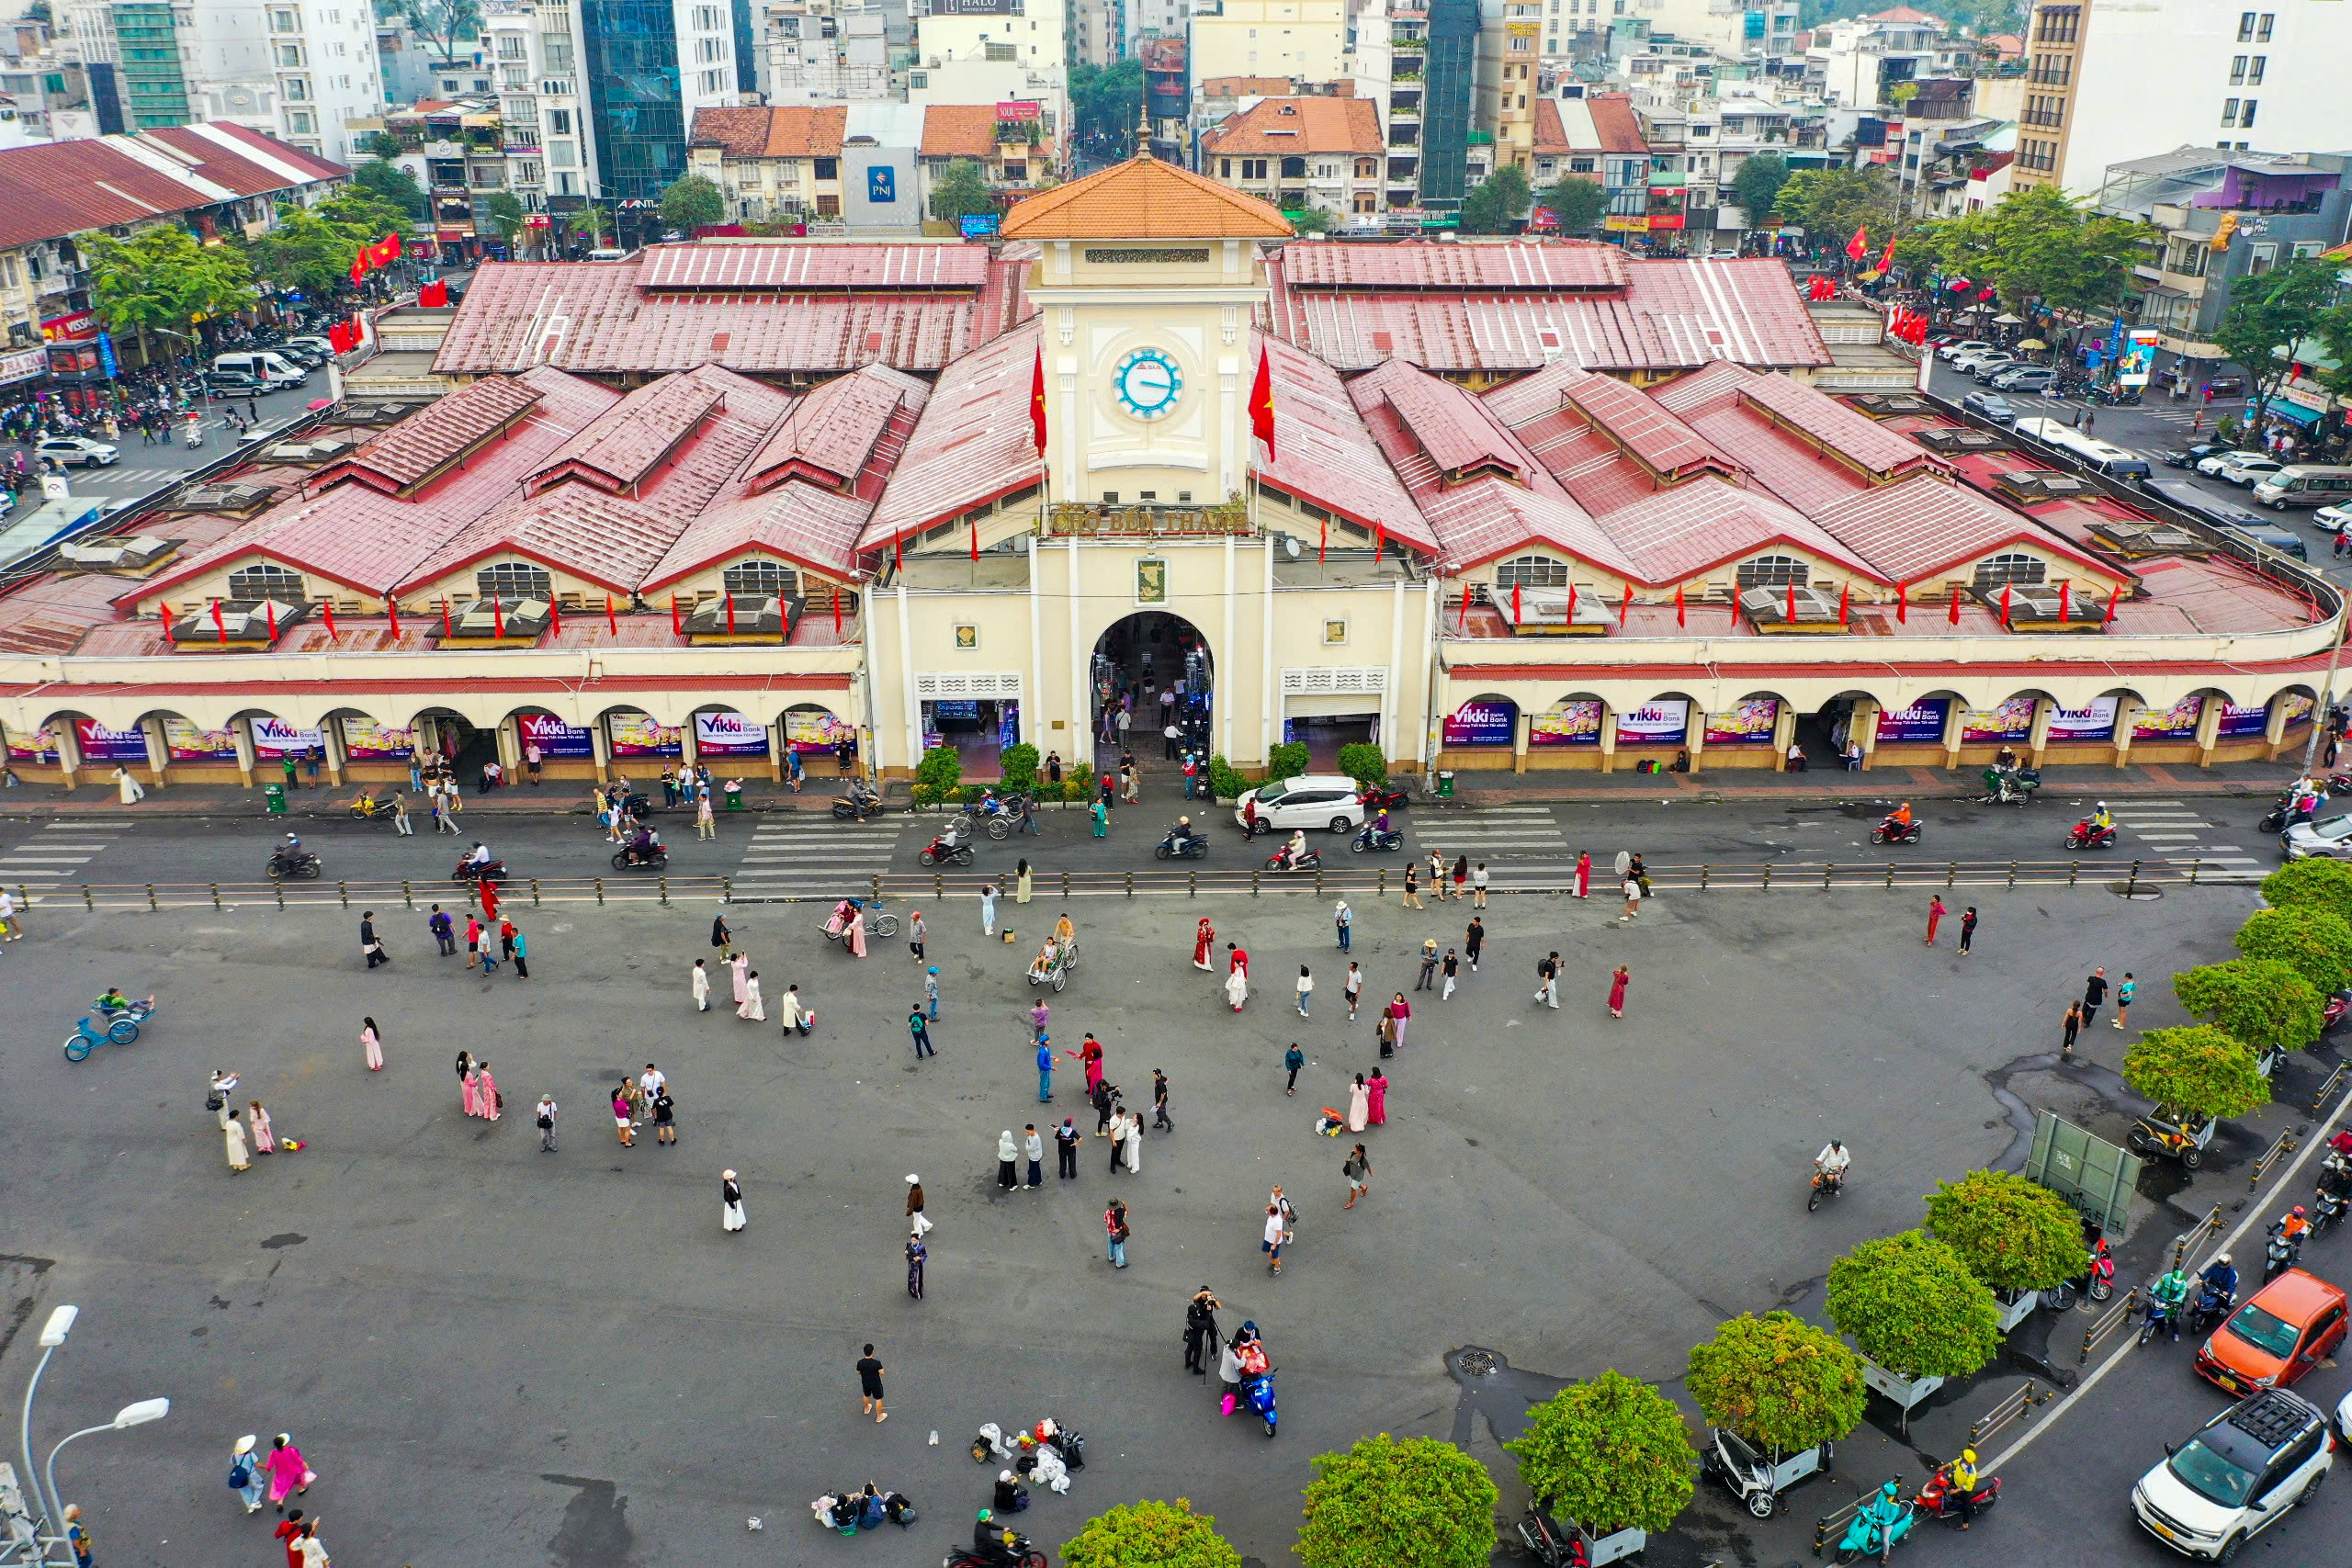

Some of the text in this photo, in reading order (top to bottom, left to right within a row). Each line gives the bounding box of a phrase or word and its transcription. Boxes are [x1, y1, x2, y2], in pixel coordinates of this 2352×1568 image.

[1000, 107, 1015, 118] SOUL
[873, 186, 891, 198] PNJ
[1109, 505, 1154, 532] BẾN
[701, 713, 741, 733] Vikki
[1454, 703, 1488, 723] Vikki
[257, 716, 298, 738] Vikki
[525, 715, 565, 735] Vikki
